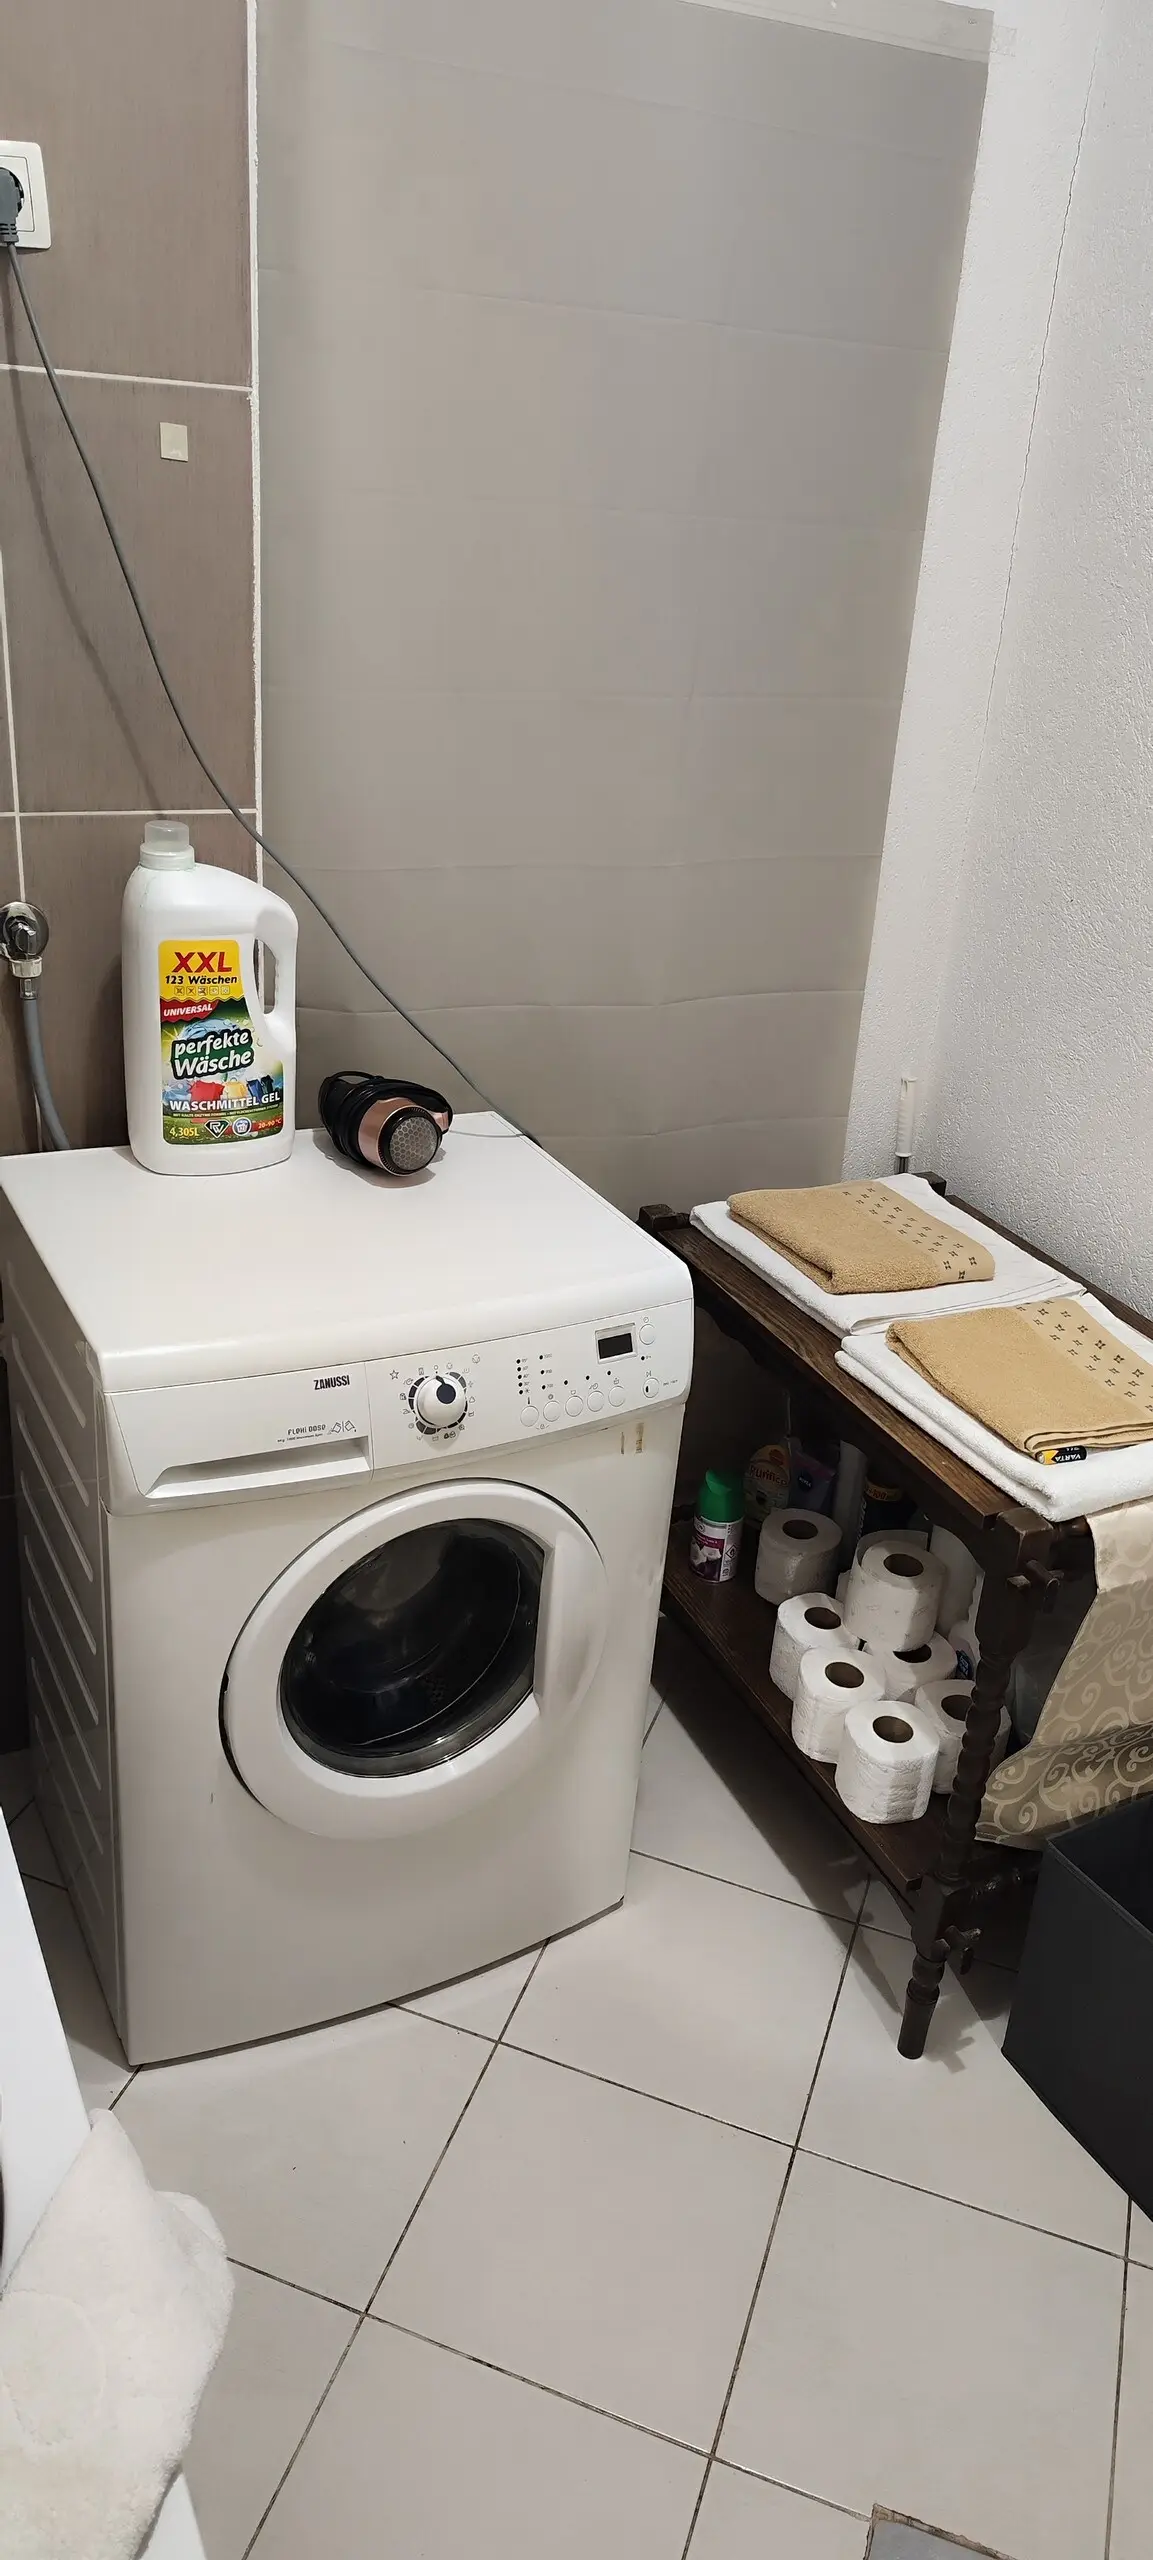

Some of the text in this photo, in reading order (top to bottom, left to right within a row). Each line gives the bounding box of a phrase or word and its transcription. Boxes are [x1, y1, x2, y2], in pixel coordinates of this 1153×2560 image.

[172, 951, 232, 973] XXL
[165, 975, 238, 985] 123 Wäschen
[163, 1003, 213, 1017] UNIVERSAL
[174, 1031, 250, 1059] perfekte
[174, 1050, 251, 1077] Wäsche
[169, 1097, 260, 1111] WASCHMITTEL
[261, 1091, 281, 1104] GEL
[169, 1127, 200, 1138] 4,305L
[313, 1374, 351, 1391] ZANUSSI
[1054, 1453, 1081, 1462] VARTA
